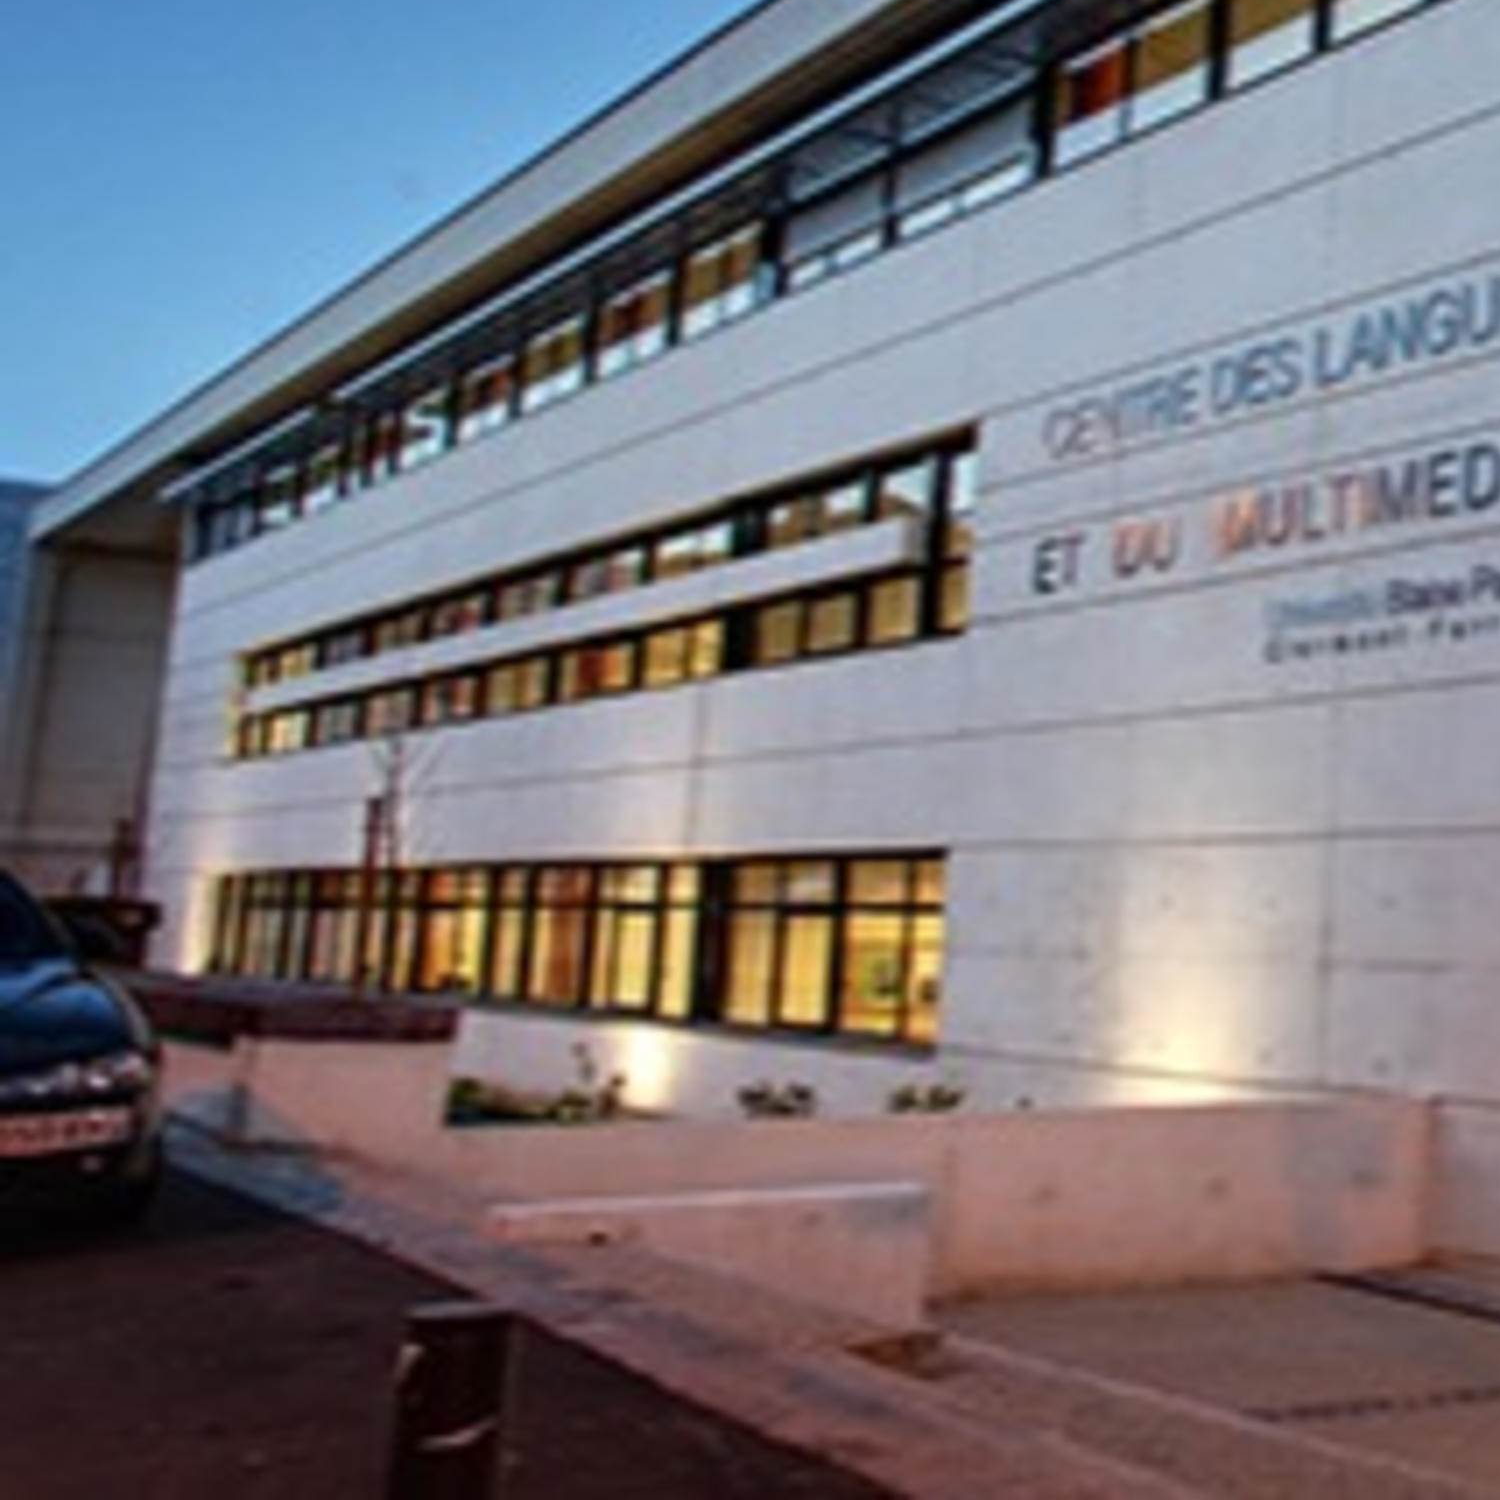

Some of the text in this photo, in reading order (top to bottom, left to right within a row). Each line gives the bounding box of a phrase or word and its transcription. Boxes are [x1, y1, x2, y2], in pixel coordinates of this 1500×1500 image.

[1041, 366, 1201, 460] CENTRE
[1210, 338, 1303, 415] DES
[1032, 528, 1086, 594] ET
[1112, 516, 1182, 579] DU
